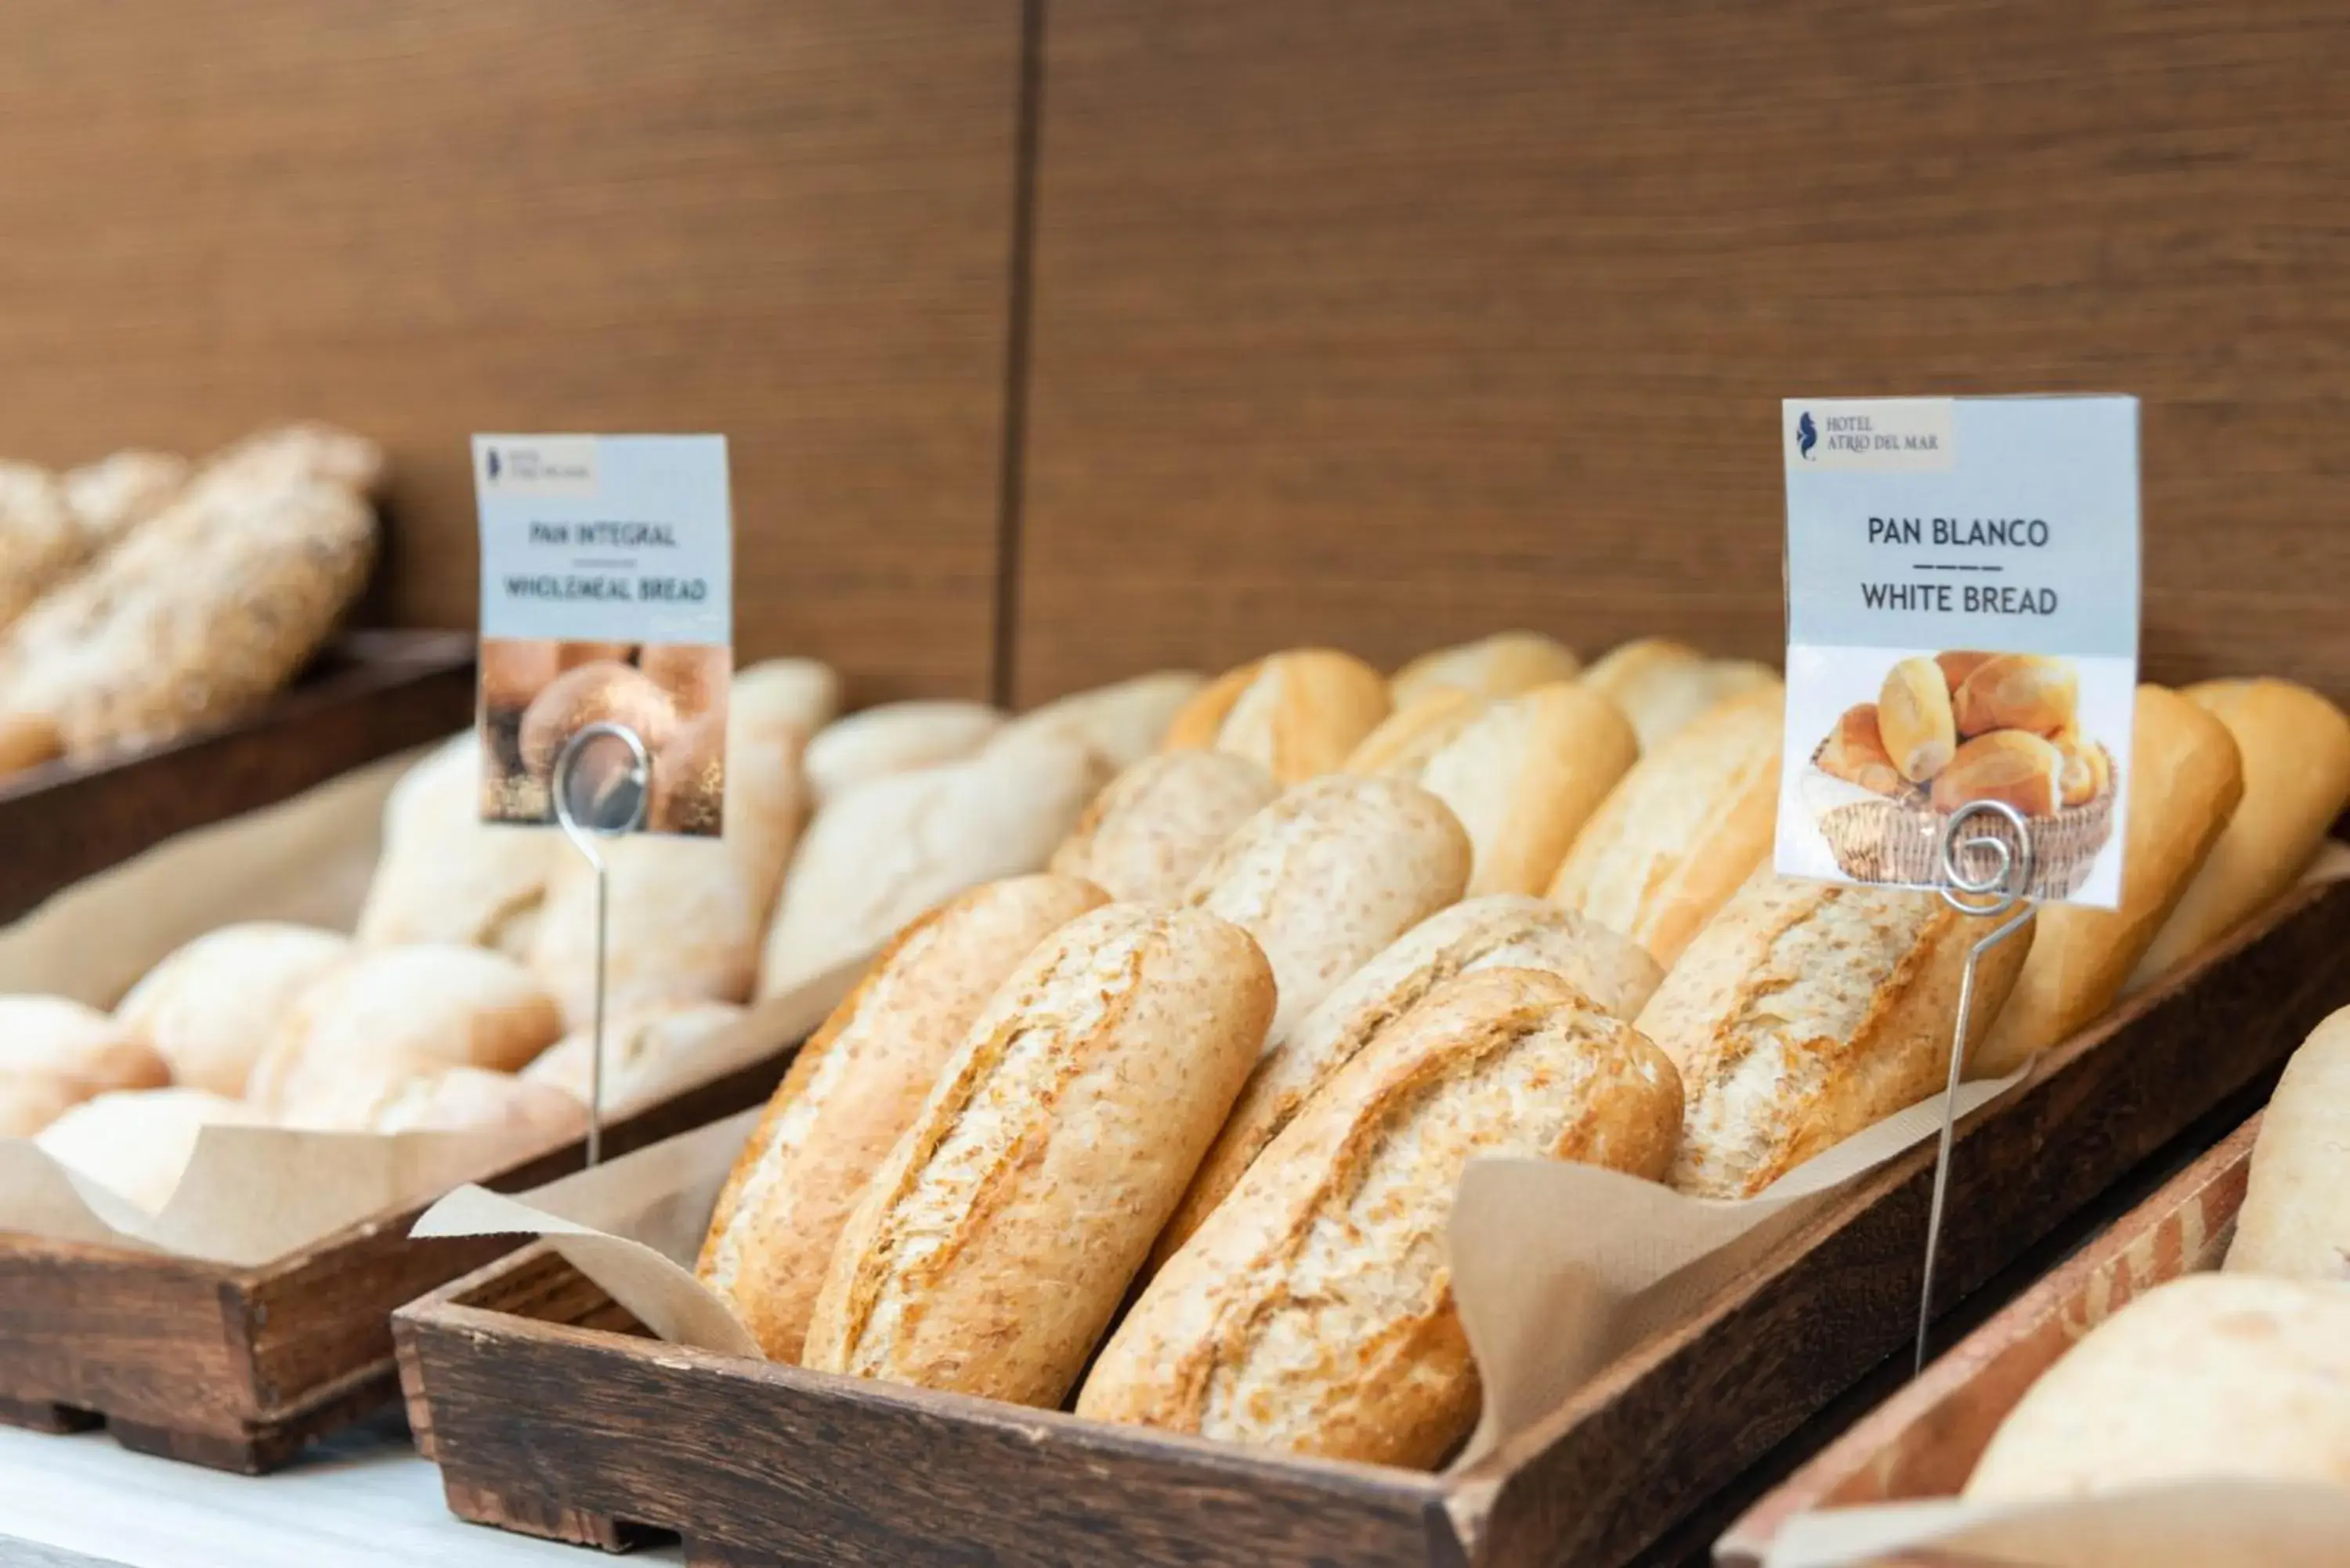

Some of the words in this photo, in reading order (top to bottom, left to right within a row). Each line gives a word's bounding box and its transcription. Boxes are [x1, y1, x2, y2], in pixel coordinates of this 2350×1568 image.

[1826, 416, 1873, 431] HOTEL
[1827, 435, 1870, 452] ATRIO
[1875, 435, 1900, 450] DEL
[1904, 435, 1939, 450] MAR
[530, 521, 569, 544] PAN
[576, 521, 677, 547] INTEGRAL
[1868, 517, 1922, 544] PAN
[1932, 518, 2050, 547] BLANCO
[638, 576, 707, 603] BREAD
[1861, 583, 1953, 612] WHITE
[1964, 586, 2058, 616] BREAD
